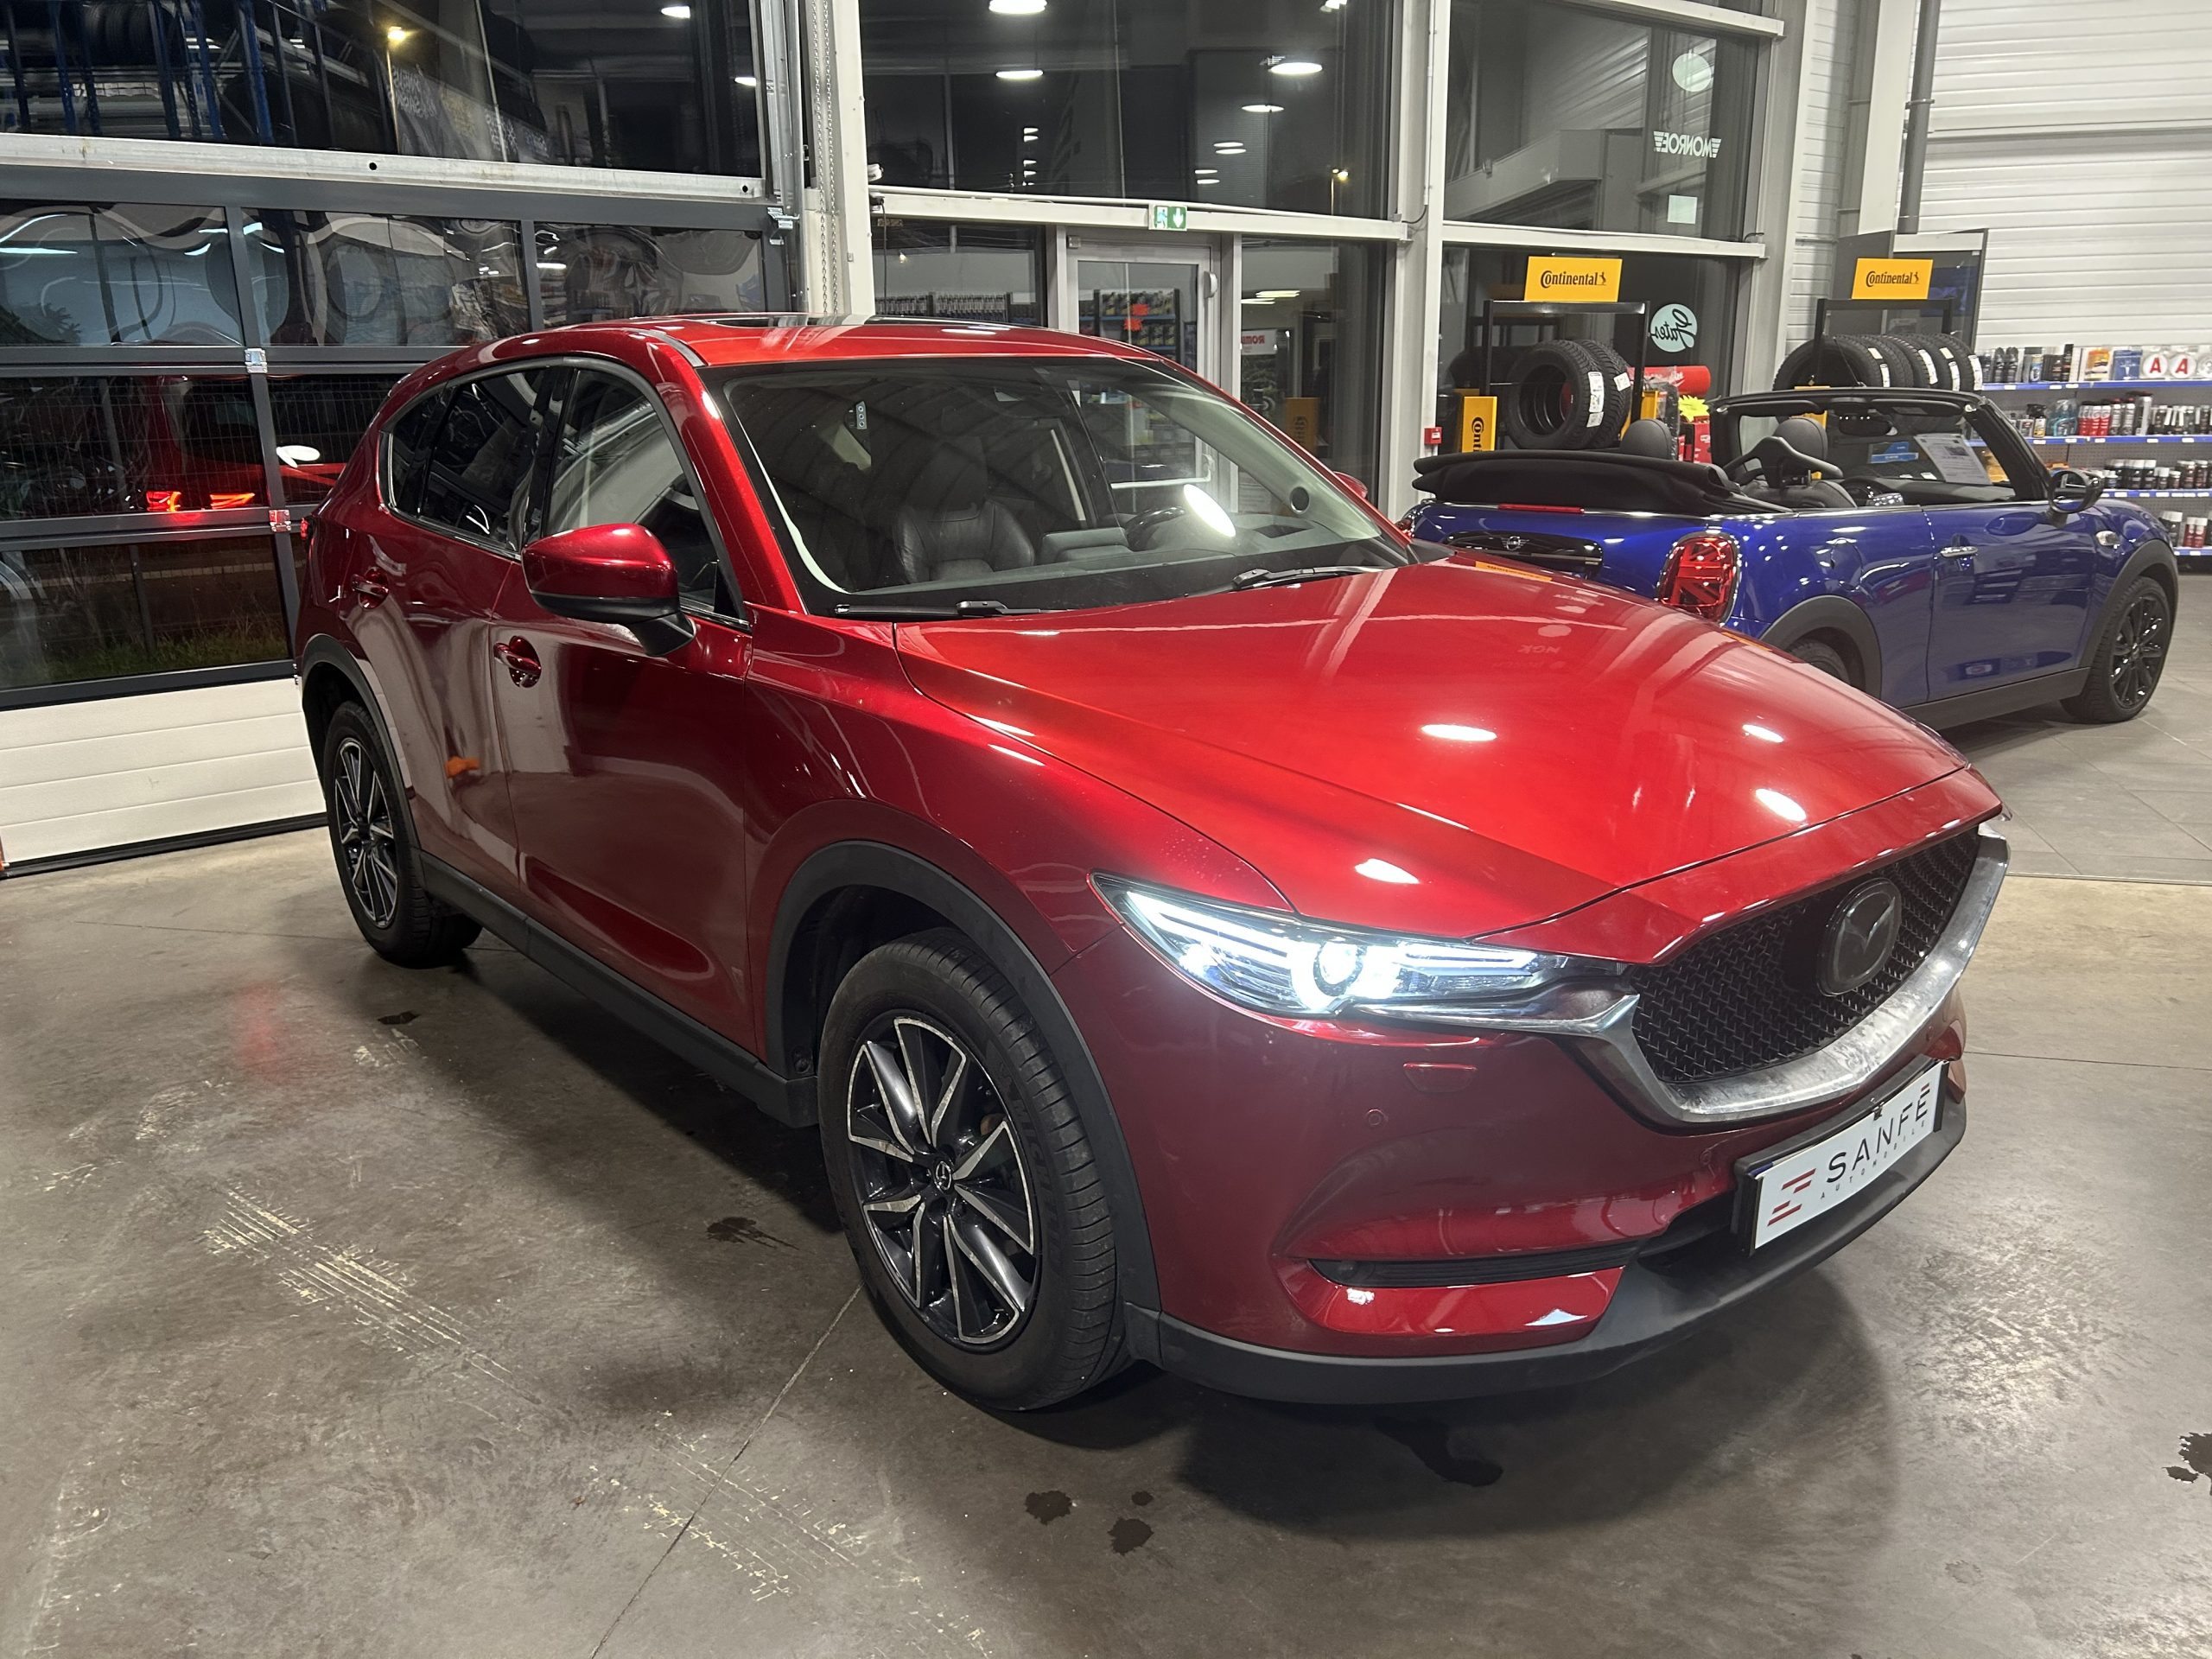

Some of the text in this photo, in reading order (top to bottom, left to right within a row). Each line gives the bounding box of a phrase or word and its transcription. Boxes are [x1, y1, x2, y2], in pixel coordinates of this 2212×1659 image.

[1541, 270, 1598, 288] Continental
[1866, 270, 1912, 287] Continental
[2150, 358, 2161, 373] A
[2175, 358, 2188, 374] A
